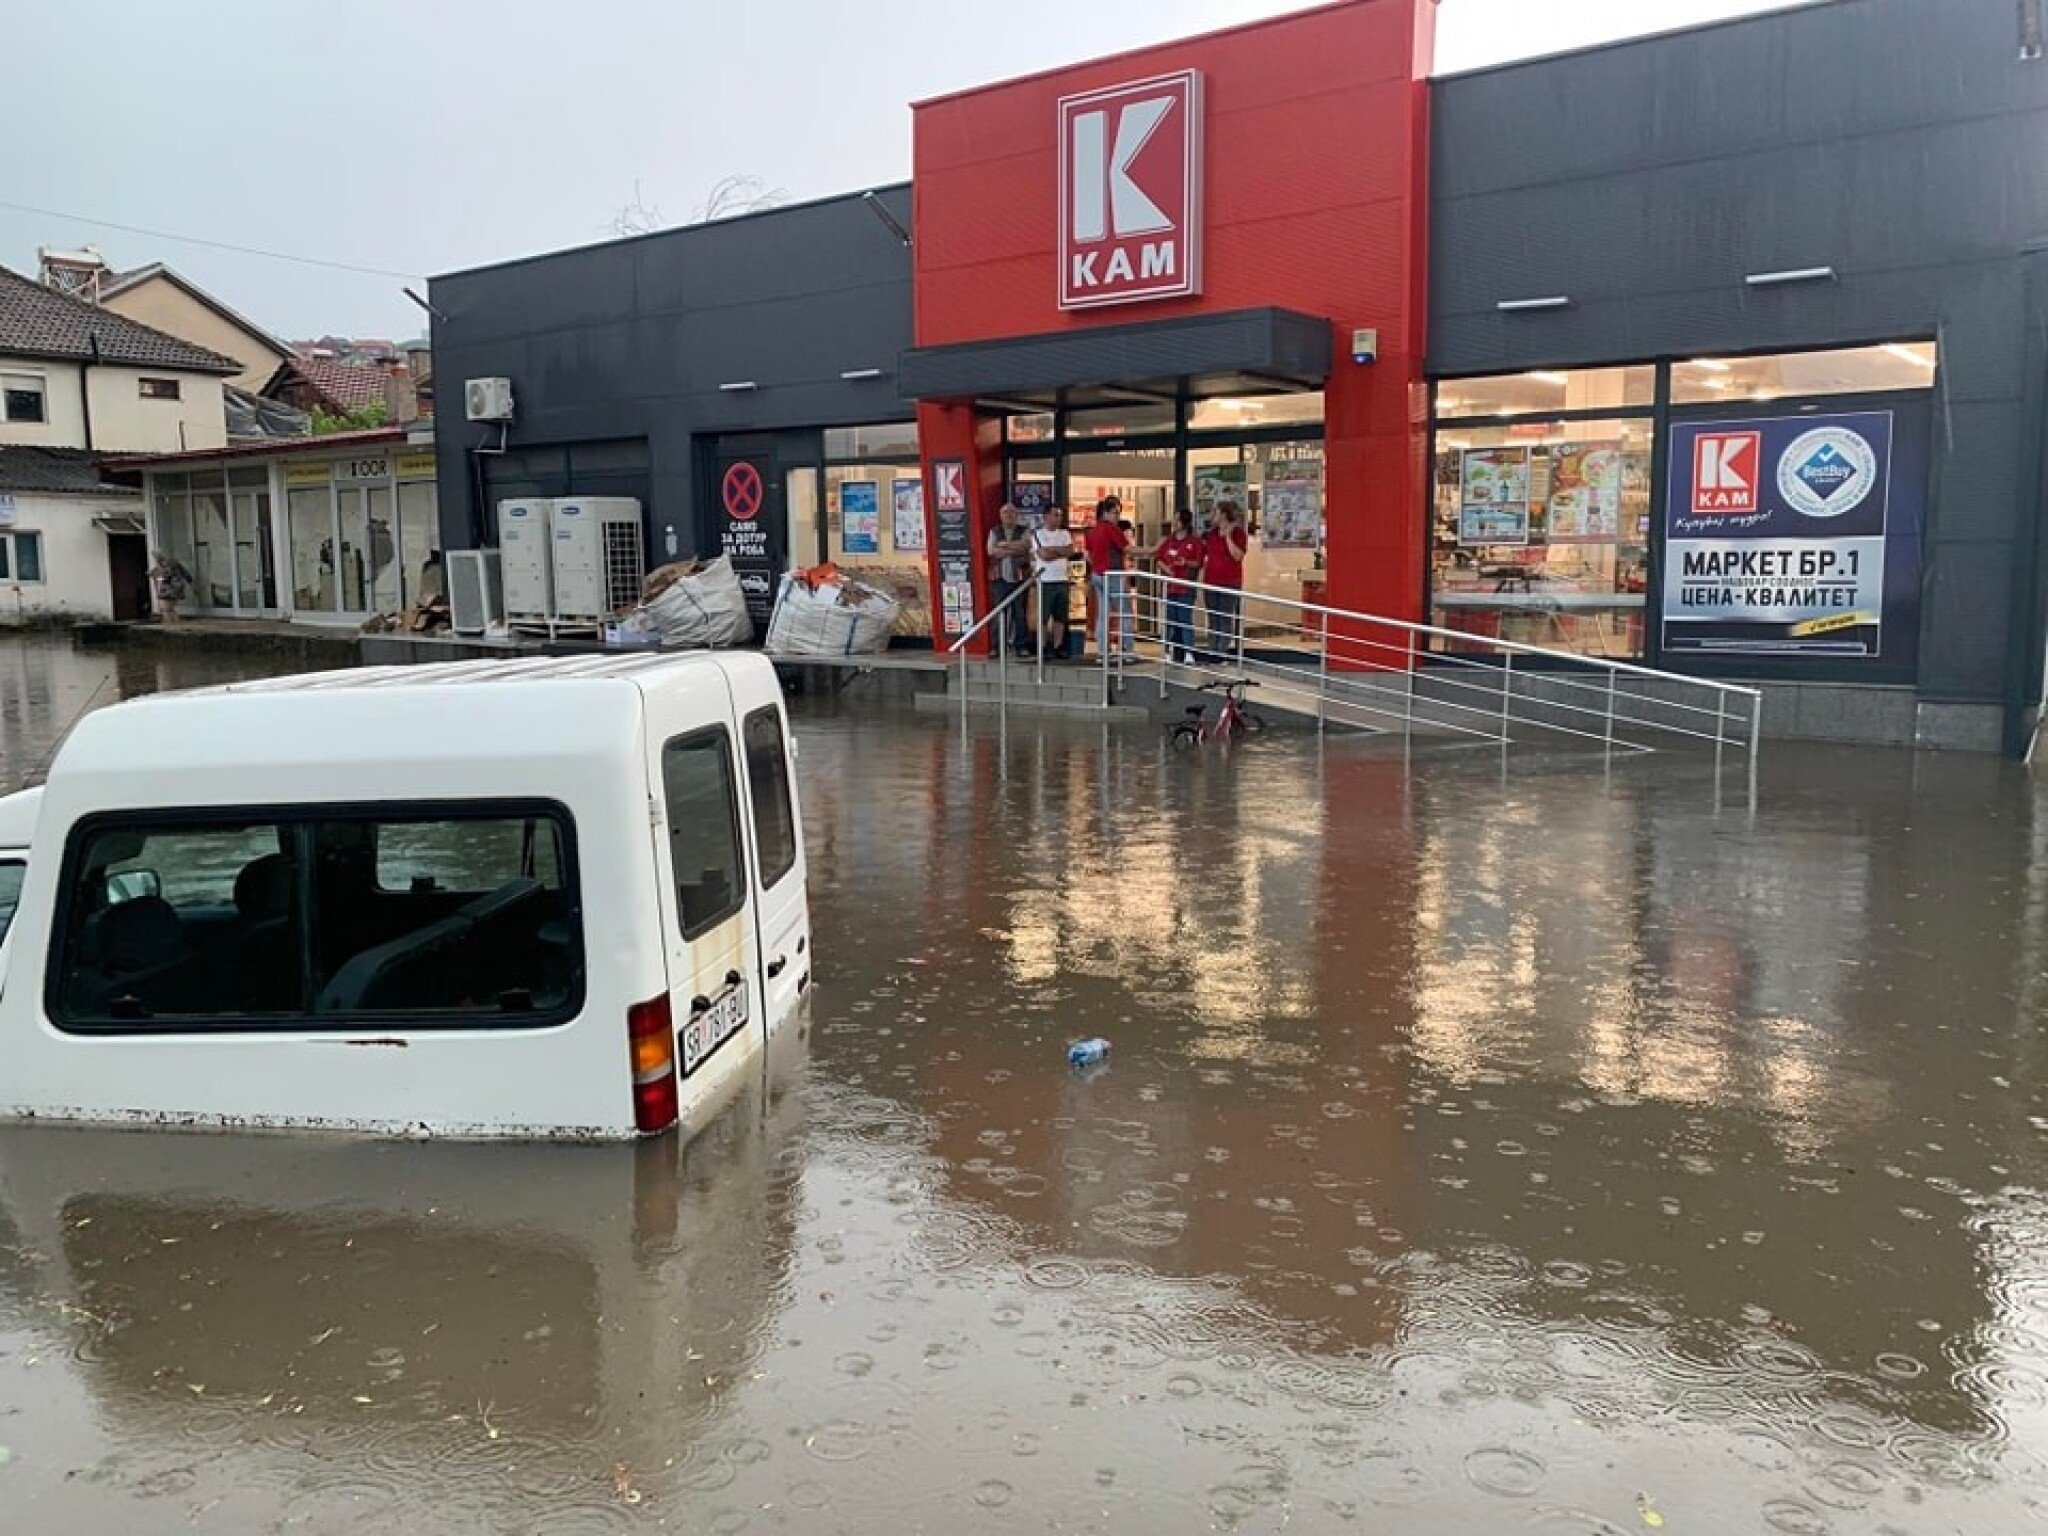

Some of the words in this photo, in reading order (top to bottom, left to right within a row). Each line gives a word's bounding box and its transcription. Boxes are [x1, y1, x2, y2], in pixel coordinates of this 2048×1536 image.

[1682, 550, 1793, 577] МАРКЕТ
[1799, 550, 1859, 577] БР.1
[1681, 588, 1859, 608] ЦЕНА-КВАЛИТЕТ
